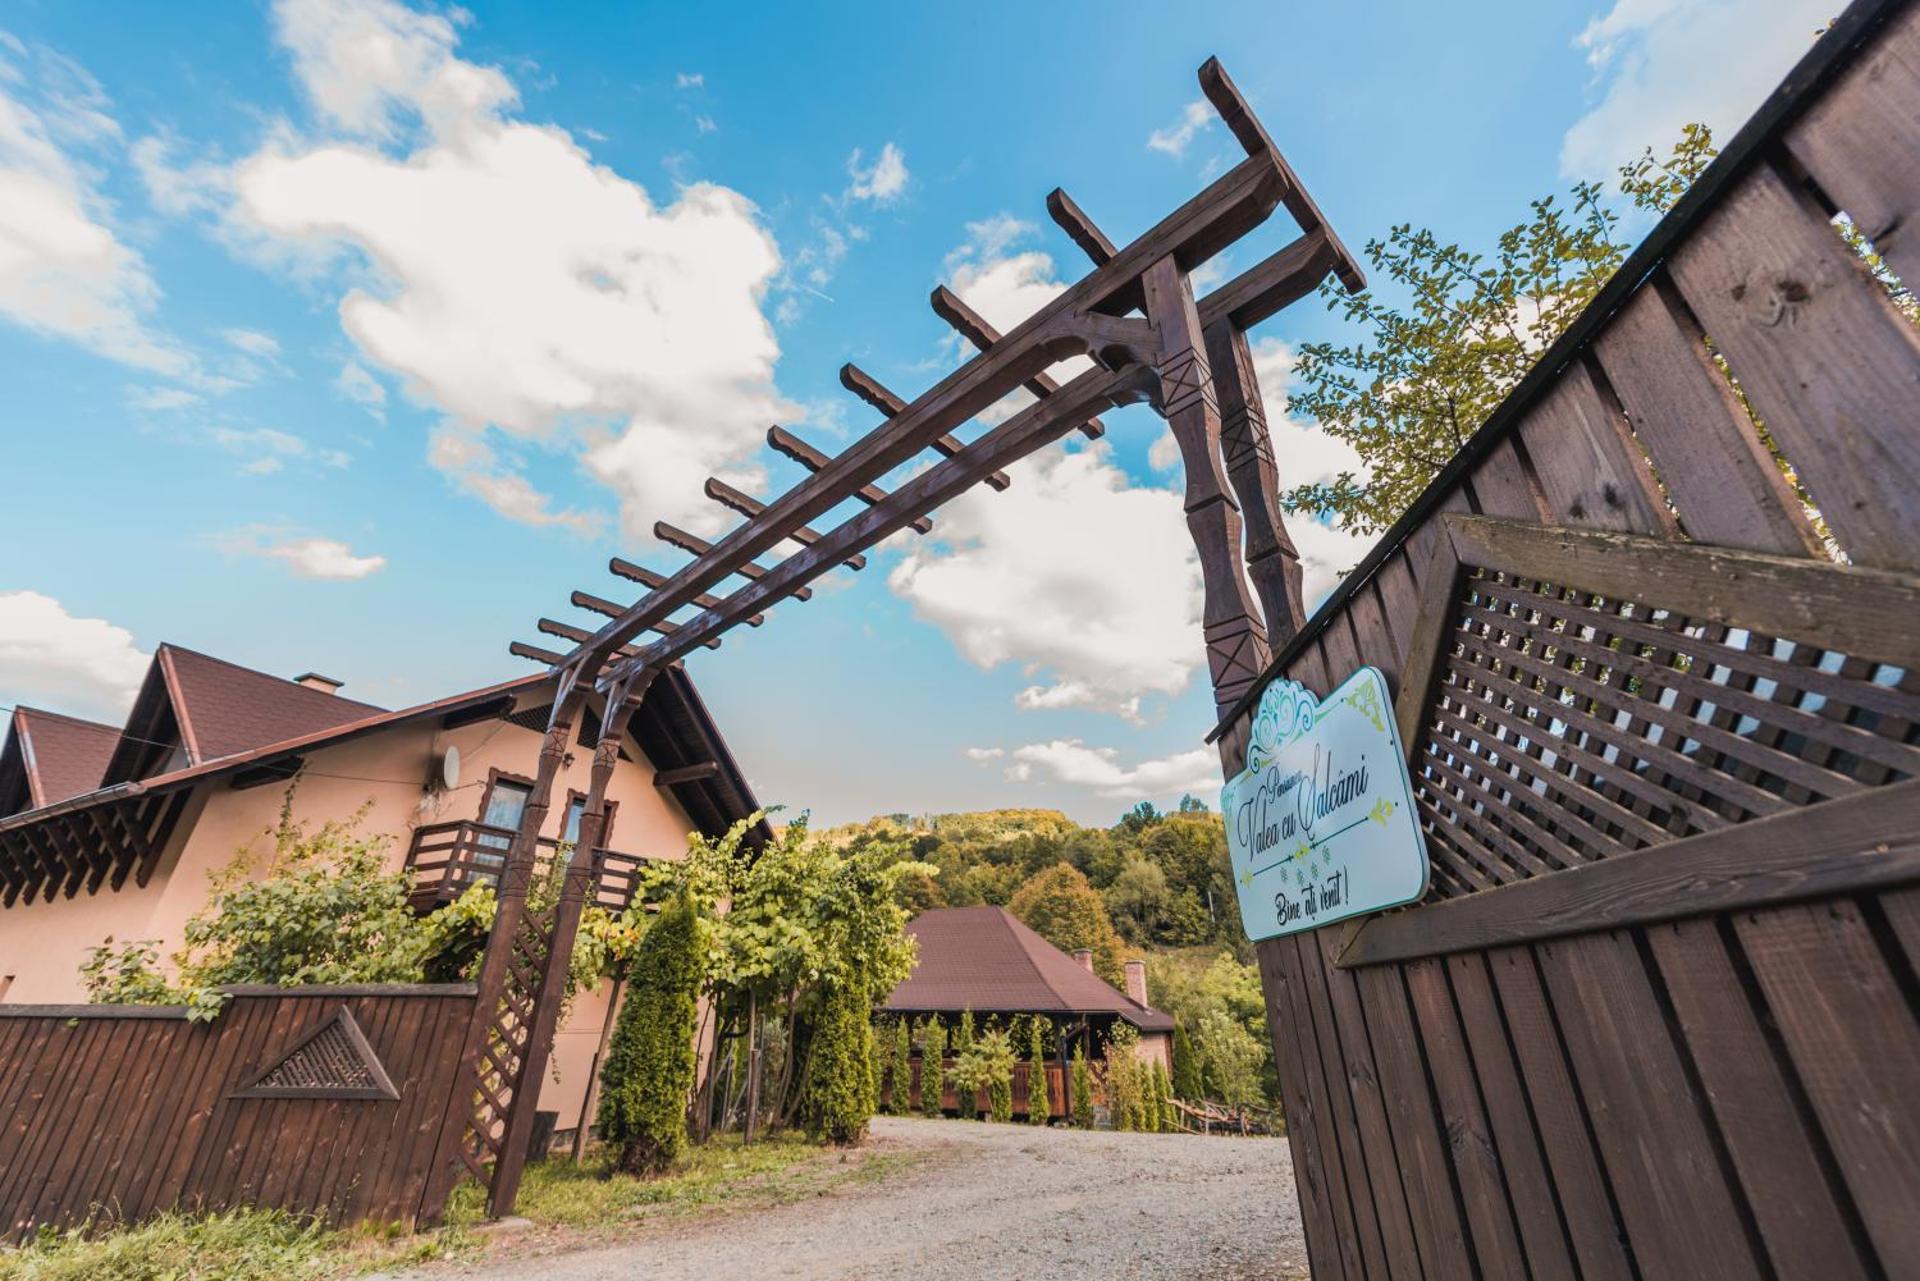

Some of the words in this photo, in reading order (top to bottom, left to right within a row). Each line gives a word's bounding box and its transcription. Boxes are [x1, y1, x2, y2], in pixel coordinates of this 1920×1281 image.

[1238, 785, 1280, 863] Valea
[1282, 812, 1297, 840] cu
[1275, 892, 1302, 926] Bine
